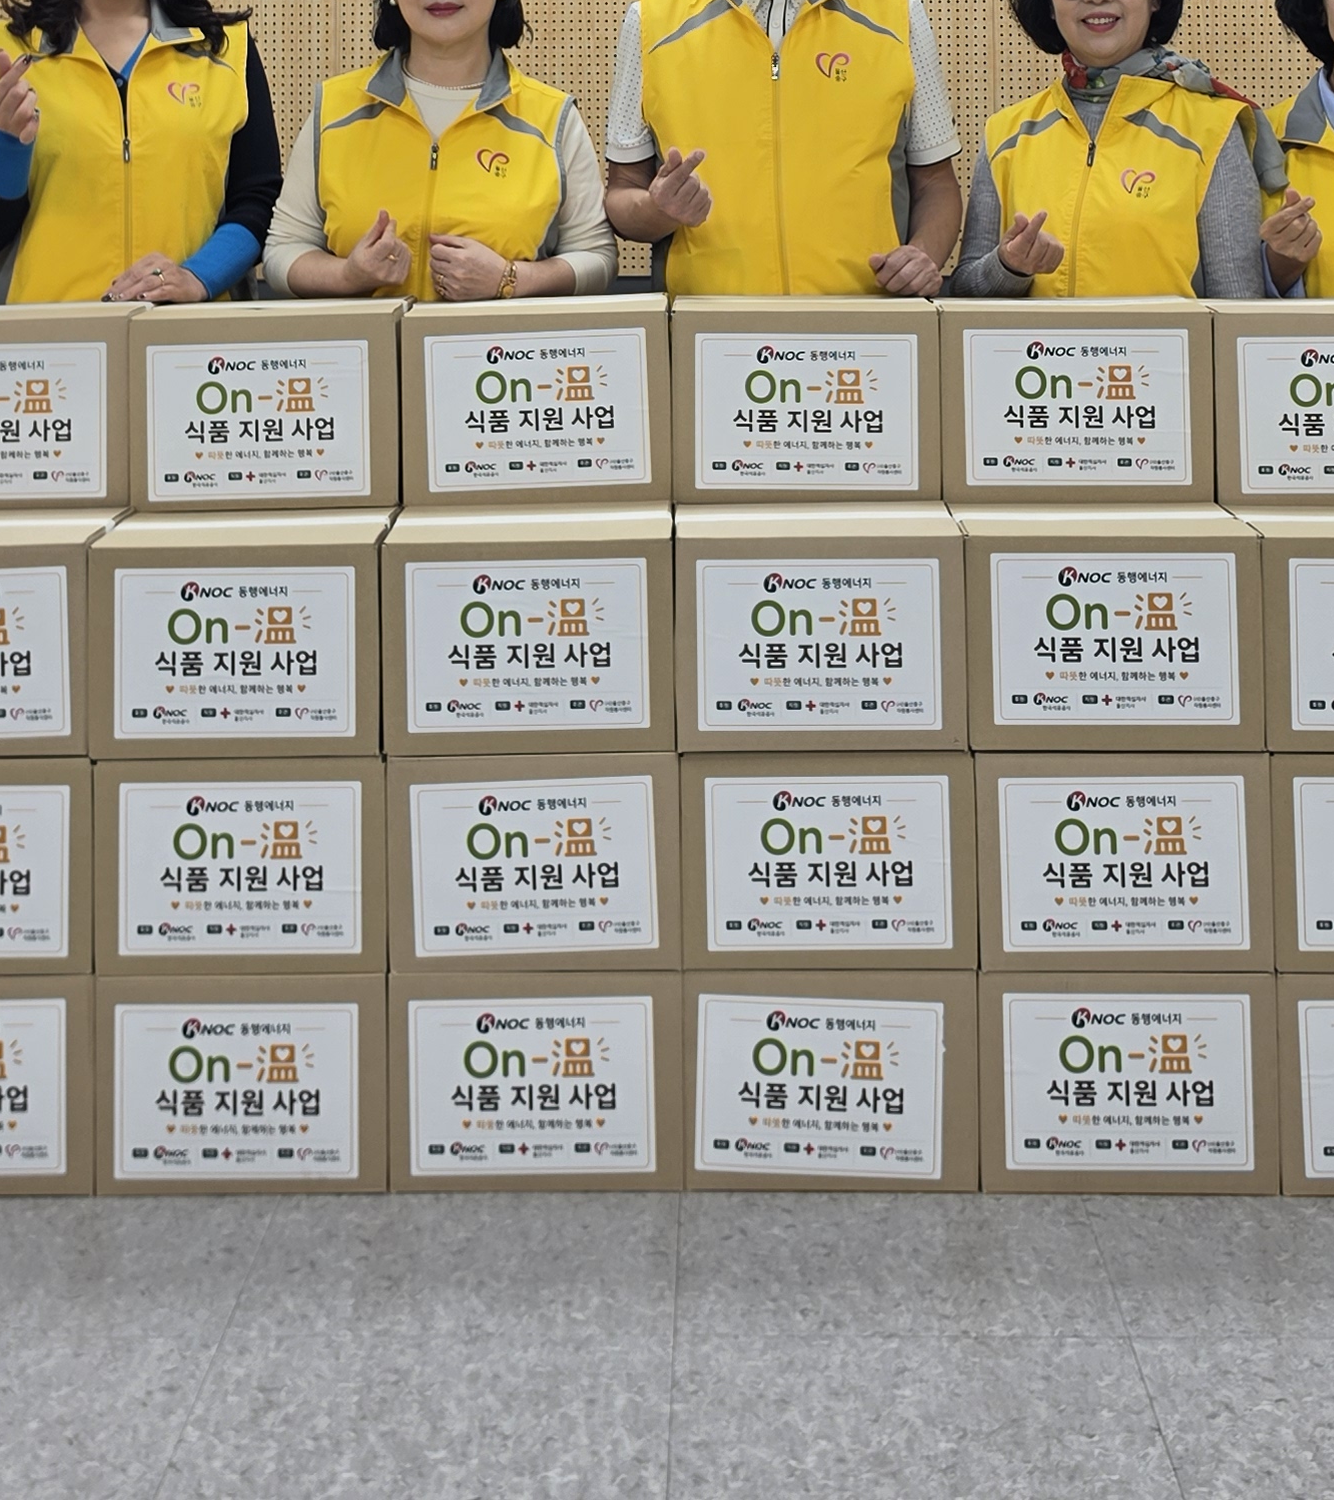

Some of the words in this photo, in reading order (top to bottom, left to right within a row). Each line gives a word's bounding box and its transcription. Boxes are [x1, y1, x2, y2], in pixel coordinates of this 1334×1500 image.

[756, 345, 805, 364] KNOC
[809, 350, 855, 361] 동행에너지
[28, 418, 71, 442] 사업
[733, 409, 778, 432] 식품
[787, 409, 832, 432] 지원
[839, 410, 883, 433] 사업
[1278, 412, 1325, 437] 식품
[756, 441, 780, 449] 따뜻한
[812, 441, 842, 450] 함께하는
[845, 441, 861, 449] 행복
[180, 580, 233, 601] KNOC
[237, 585, 287, 597] 동행에너지
[154, 651, 204, 677] 식품
[213, 650, 261, 676] 지원
[270, 650, 317, 676] 사업
[772, 789, 826, 811] KNOC
[830, 794, 881, 807] 동행에너지
[748, 861, 798, 888] 식품
[807, 861, 857, 887] 지원
[865, 860, 913, 887] 사업
[475, 1011, 530, 1034] KNOC
[534, 1016, 585, 1029] 동행에너지
[451, 1084, 501, 1112] 식품
[510, 1083, 560, 1111] 지원
[568, 1083, 616, 1110] 사업
